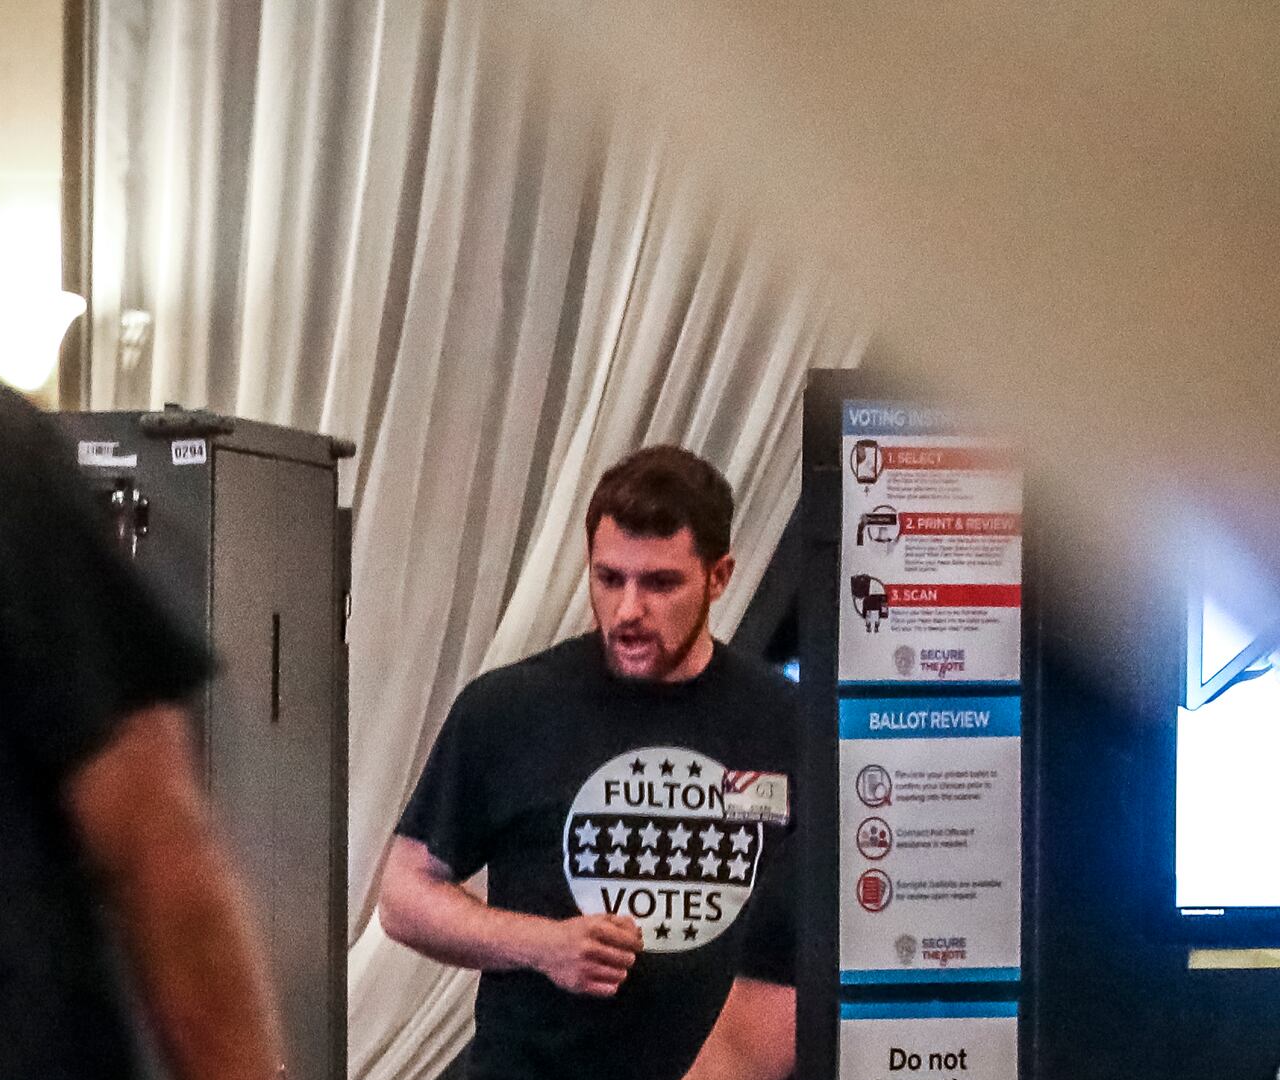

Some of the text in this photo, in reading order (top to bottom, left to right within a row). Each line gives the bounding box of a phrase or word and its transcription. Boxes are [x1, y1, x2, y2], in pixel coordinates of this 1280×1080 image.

[849, 408, 906, 426] VOTING
[918, 518, 953, 530] PRINT
[955, 518, 963, 529] &
[966, 518, 1016, 529] REVIEW
[891, 590, 938, 600] 3. SCAN
[920, 650, 965, 660] SECURE
[921, 662, 938, 671] THE
[869, 711, 990, 730] BALLOT REVIEW
[604, 780, 725, 810] FULTON
[600, 887, 723, 922] VOTES
[922, 937, 966, 948] SECURE
[890, 1048, 967, 1070] Do not
